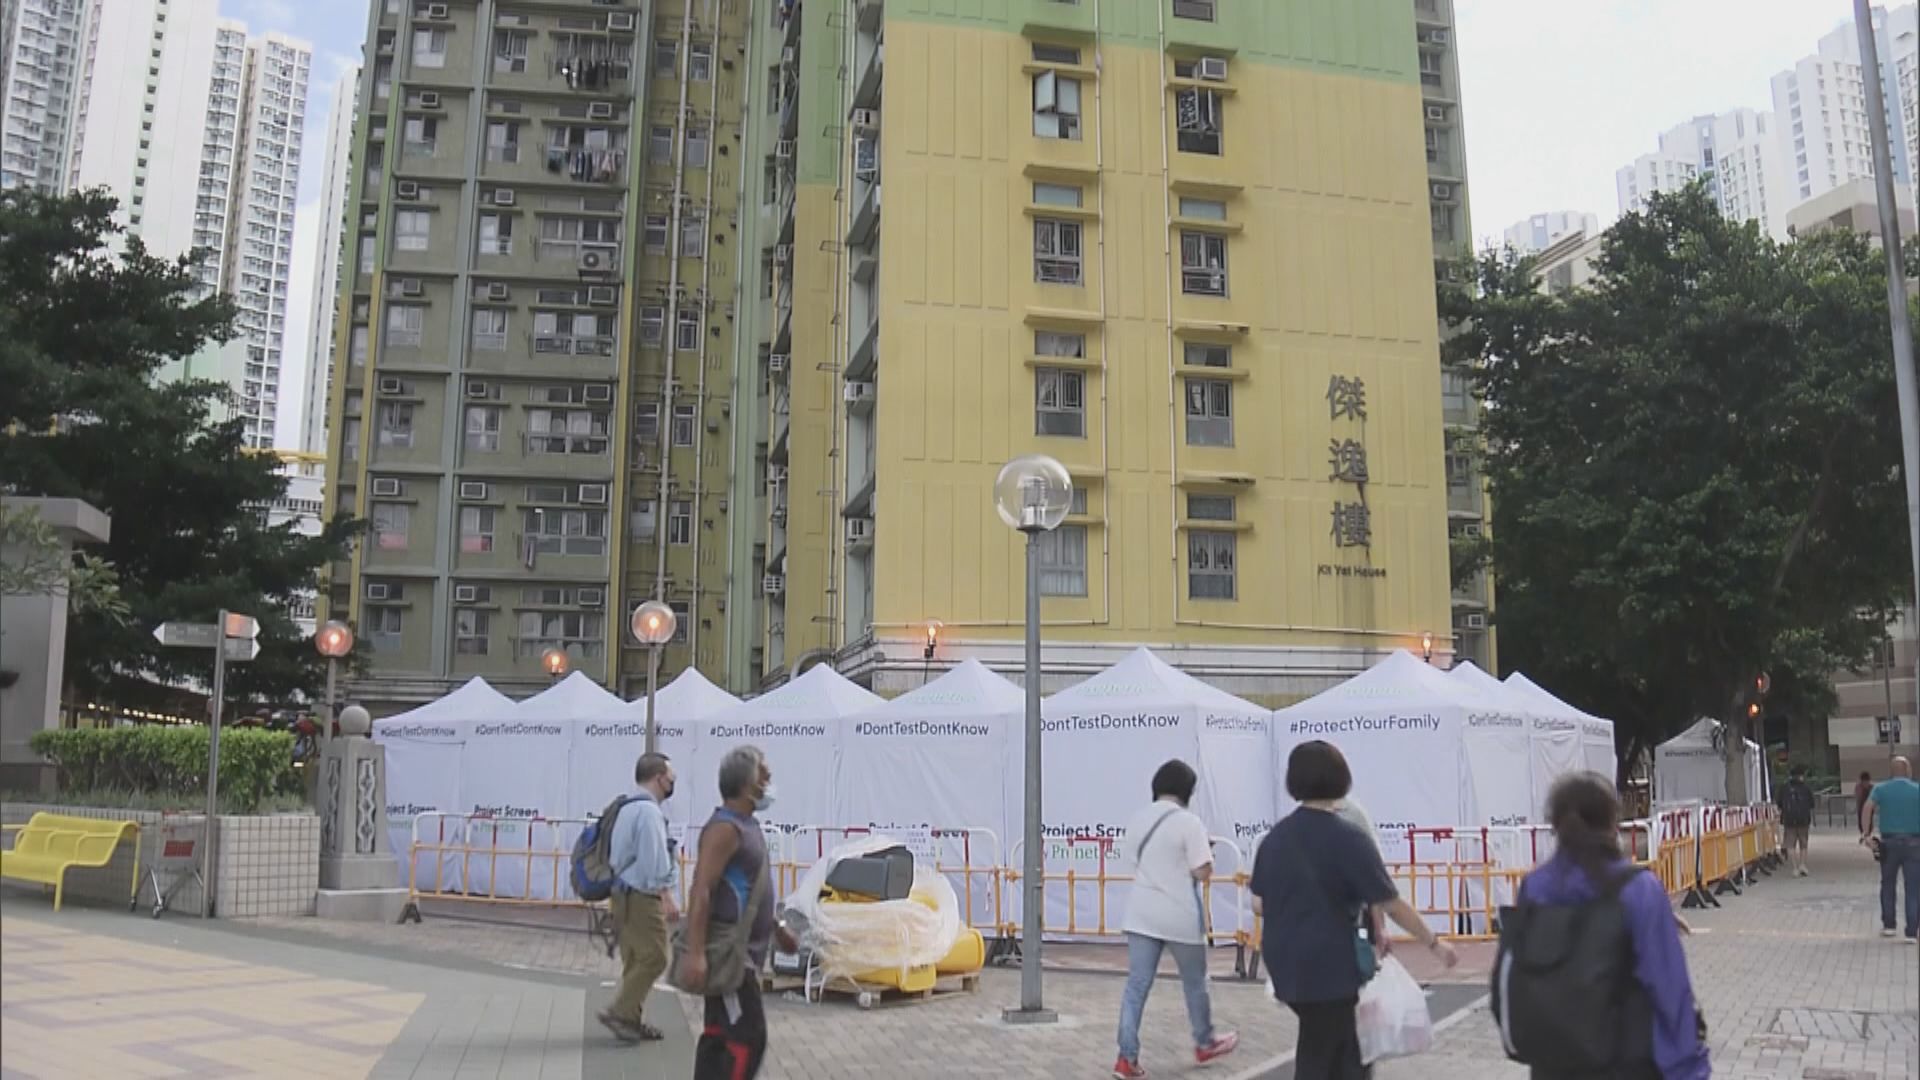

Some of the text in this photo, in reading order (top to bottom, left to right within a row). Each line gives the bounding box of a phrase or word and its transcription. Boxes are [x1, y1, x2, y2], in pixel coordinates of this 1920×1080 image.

[1325, 374, 1371, 548] 傑逸樓
[475, 723, 562, 736] #DontTestDontKnow
[585, 723, 684, 737] #DontTestDoKnow
[855, 720, 989, 736] #DontTestDontKnow
[1040, 713, 1180, 732] DontTestDontKnow
[1289, 713, 1441, 735] #ProtectYourFamily
[710, 723, 826, 738] #DontTestDontKnow
[504, 805, 539, 818] Screen
